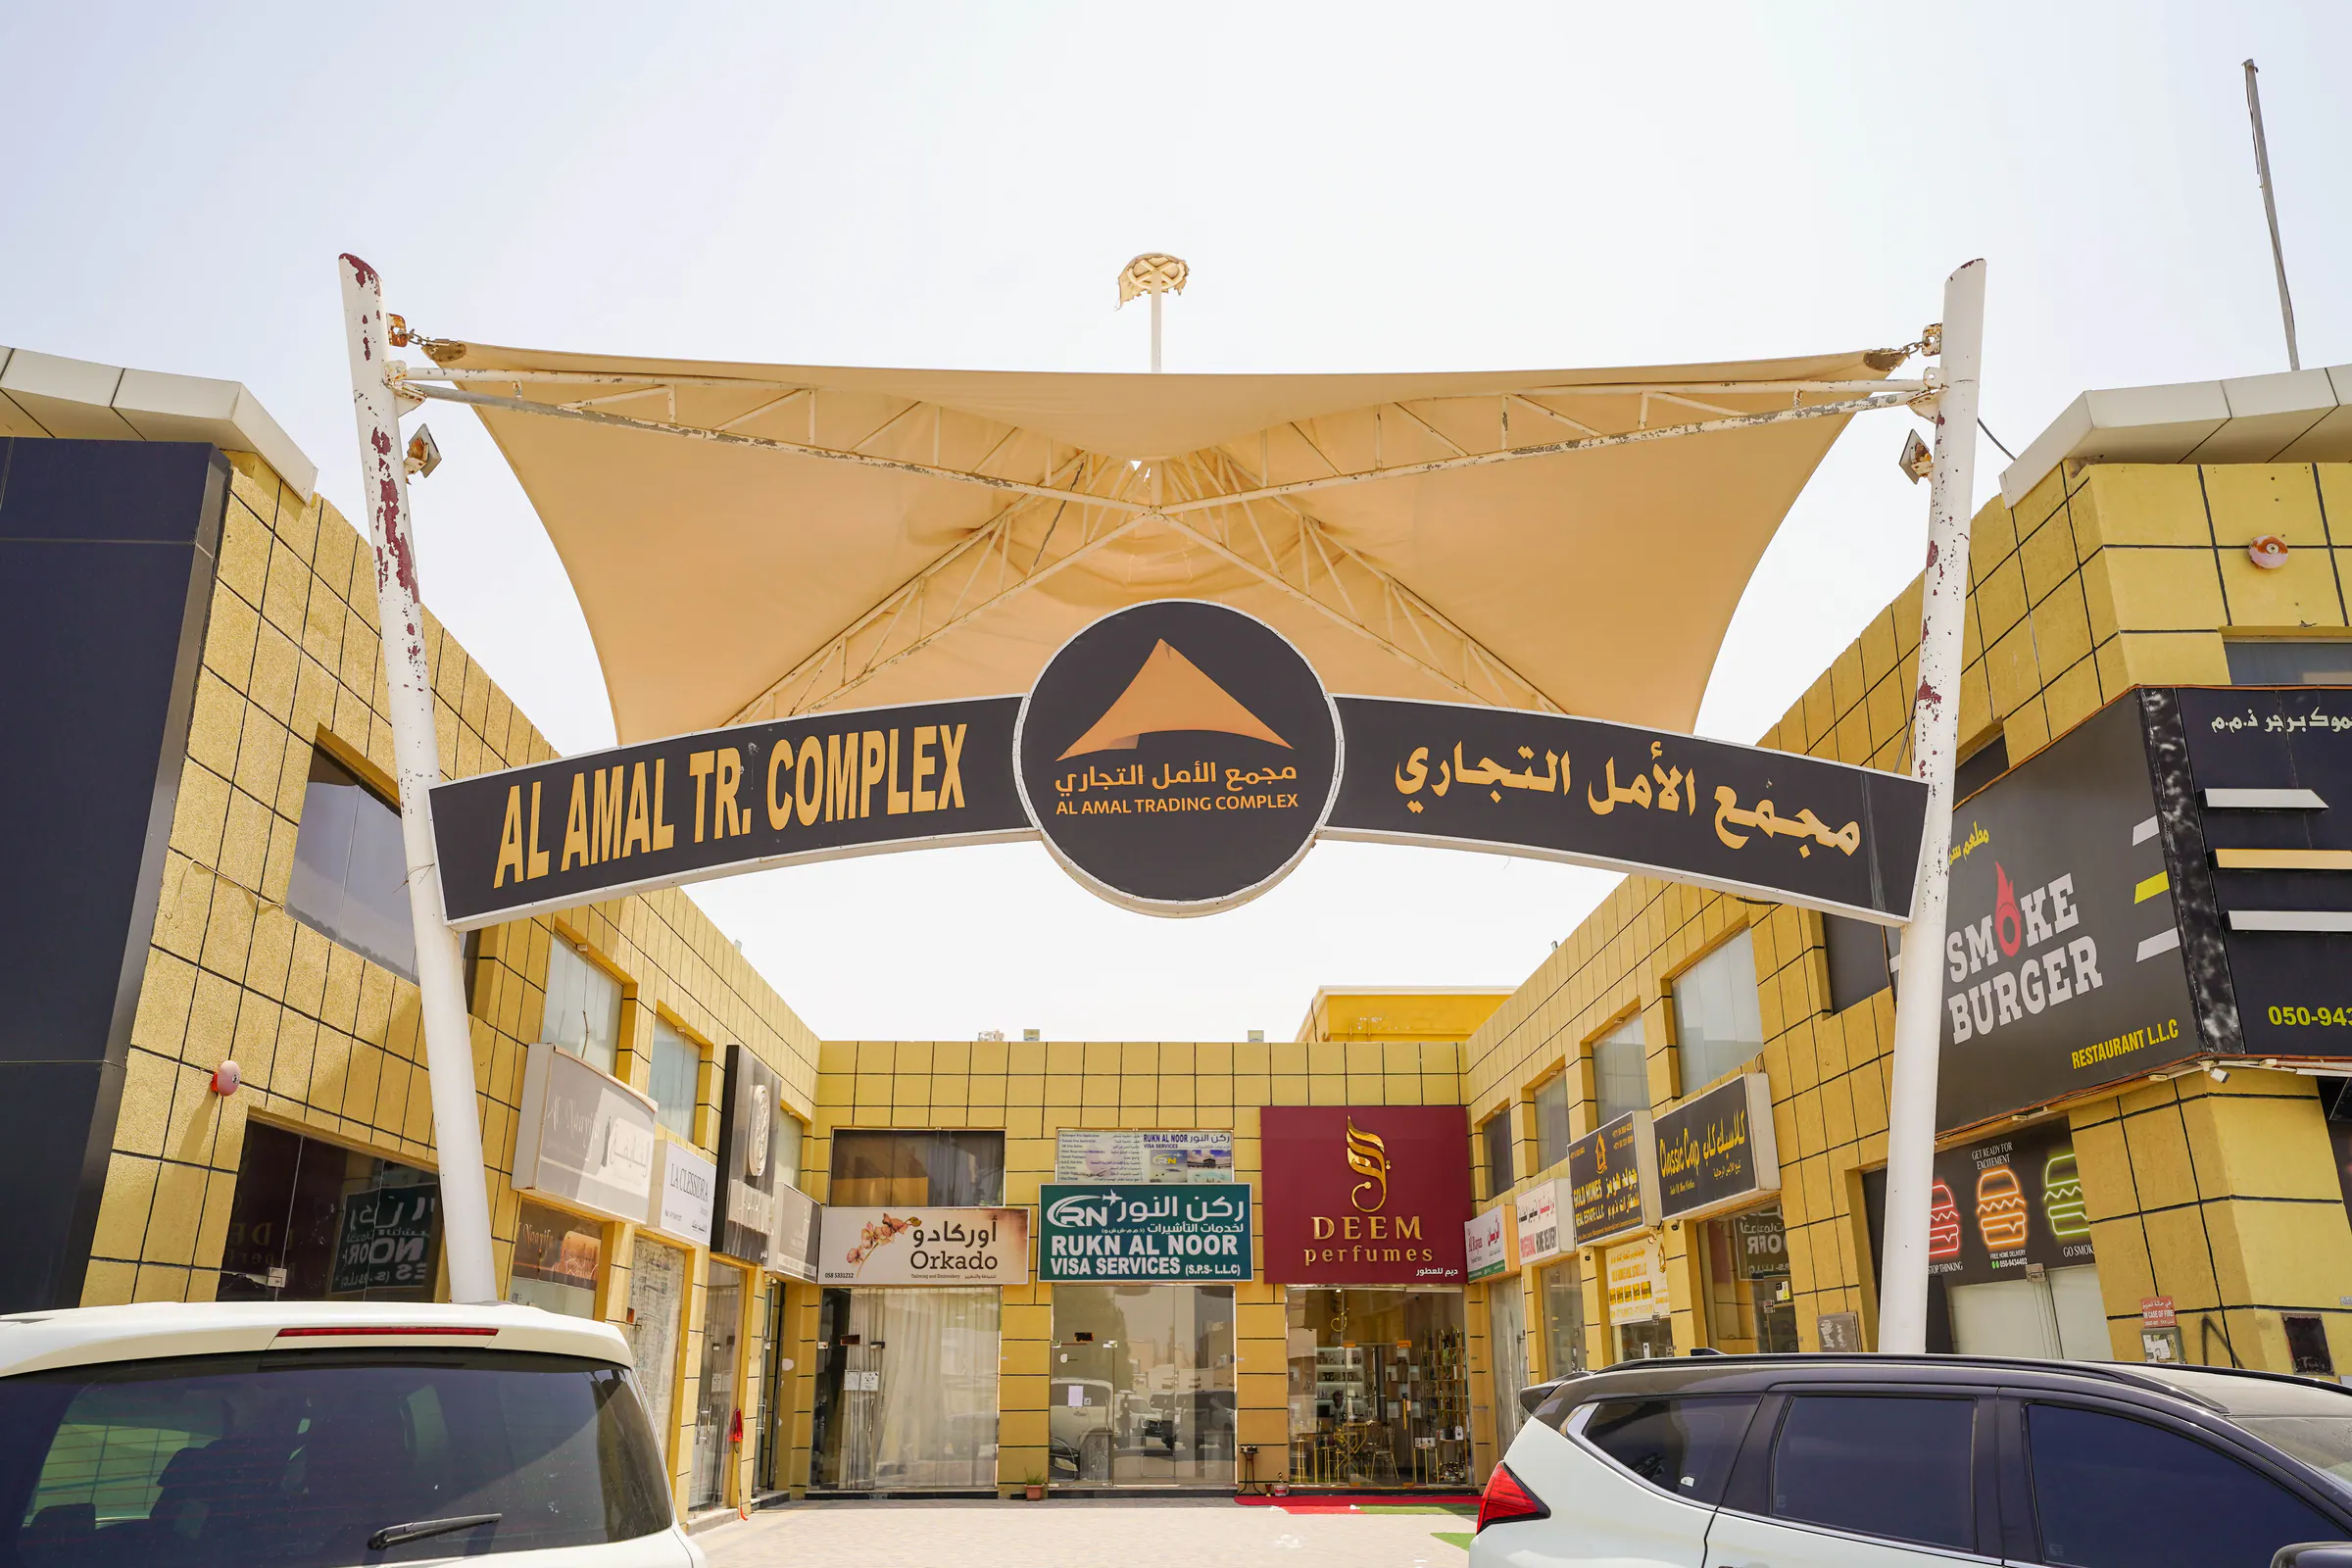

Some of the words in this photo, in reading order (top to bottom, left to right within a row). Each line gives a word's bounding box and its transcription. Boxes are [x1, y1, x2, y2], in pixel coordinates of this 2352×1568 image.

[2264, 712, 2307, 733] برجر
[1054, 763, 1144, 797] التجاري
[1152, 760, 1217, 790] الأمل
[1224, 765, 1298, 792] مجمع
[1395, 740, 1571, 814] التجاري
[1588, 741, 1696, 816] الأمل
[493, 780, 550, 889] AL
[560, 758, 675, 872] AMAL
[689, 747, 752, 844] TR.
[765, 723, 968, 831] COMPLEX
[1055, 800, 1078, 815] AL
[1081, 798, 1132, 814] AMAL
[1134, 797, 1212, 813] TRADING
[1215, 793, 1298, 810] COMPLEX
[1714, 785, 1861, 859] مجمع
[1963, 820, 1989, 860] مطعم
[1946, 862, 2080, 983] SMOKE
[1948, 936, 2104, 1044] BURGER
[2071, 1029, 2145, 1069] RESTAURANT
[1144, 1134, 1160, 1143] RUKN
[1161, 1134, 1170, 1143] AL
[1170, 1134, 1188, 1143] NOOR
[1972, 1149, 1983, 1160] GET
[1983, 1145, 2001, 1157] READY
[2001, 1142, 2013, 1154] FOR
[1977, 1153, 2010, 1170] EXCITEMENT
[1116, 1197, 1178, 1222] النور
[1187, 1197, 1244, 1222] ركن
[912, 1215, 998, 1248] أوركادو
[1200, 1223, 1244, 1233] لخدمات
[1310, 1216, 1423, 1240] DEEM
[1052, 1235, 1120, 1255] RUKN
[1129, 1235, 1160, 1255] AL
[1168, 1235, 1238, 1255] NOOR
[1303, 1245, 1434, 1266] perfumes
[2063, 1247, 2074, 1257] GO
[909, 1250, 998, 1270] Orkado
[1051, 1257, 1091, 1275] VISA
[1096, 1256, 1180, 1275] SERVICES
[1416, 1267, 1444, 1277] للعطور
[1445, 1267, 1458, 1277] ديم
